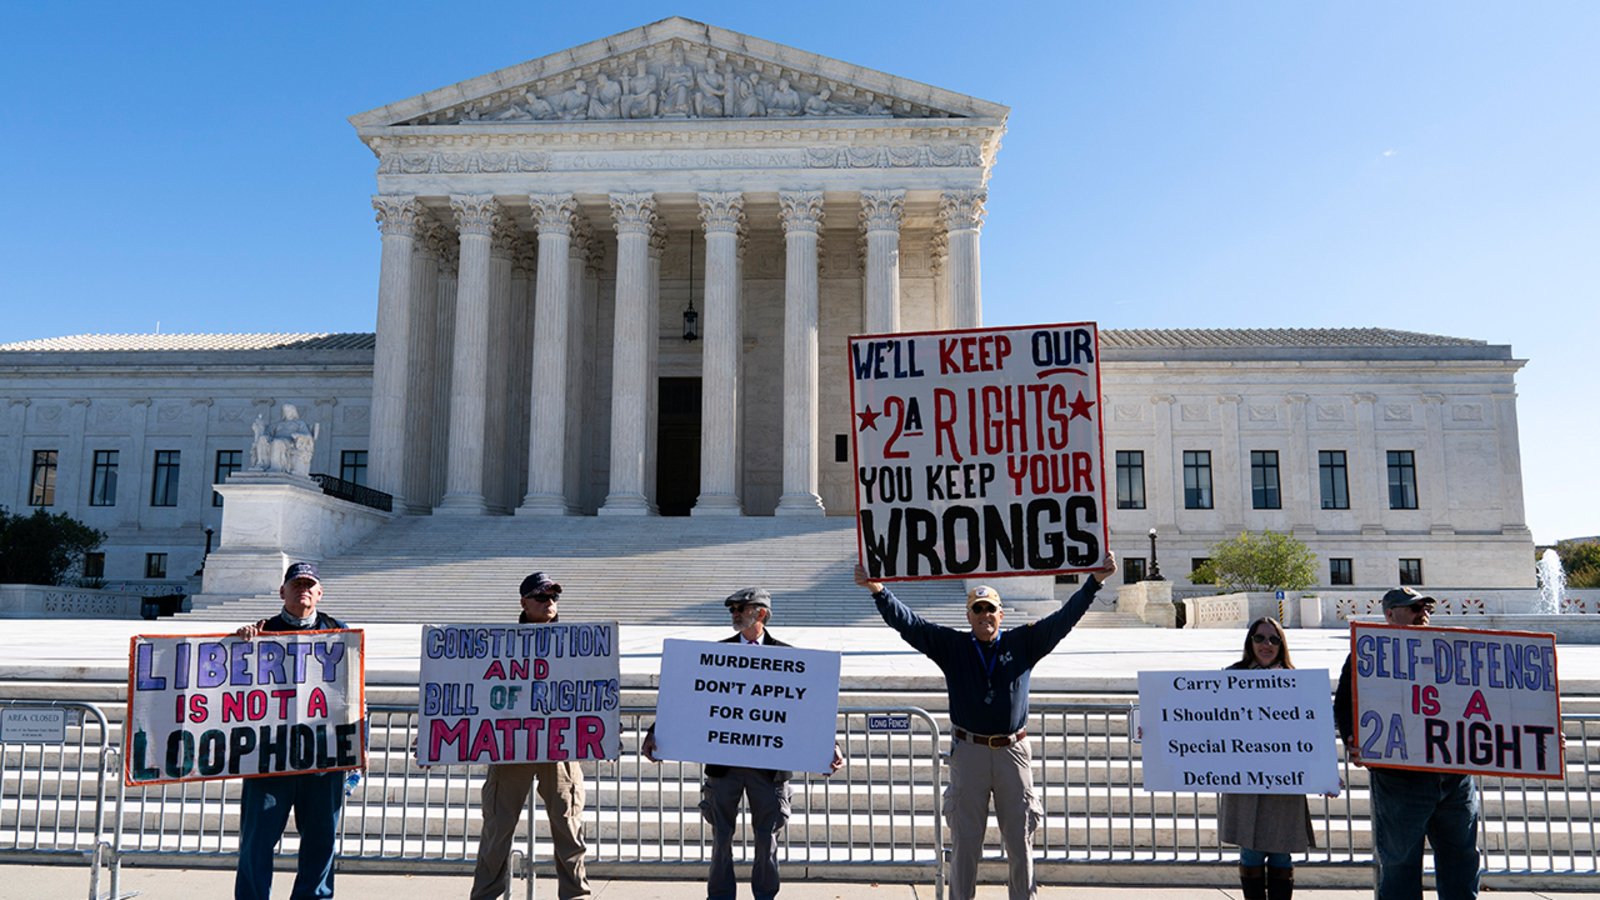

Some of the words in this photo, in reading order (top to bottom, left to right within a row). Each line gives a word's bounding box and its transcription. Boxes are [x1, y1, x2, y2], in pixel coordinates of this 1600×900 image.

[563, 155, 617, 169] EQUAL
[623, 154, 688, 168] JUSTICE
[696, 154, 752, 167] UNDER
[758, 153, 791, 166] LAW
[852, 339, 924, 380] WE'LL
[939, 335, 1012, 375] KEEP
[1031, 328, 1094, 367] OUR
[882, 395, 923, 459] 2A
[933, 383, 1070, 464] RIGHTS
[859, 465, 913, 504] YOU
[926, 462, 995, 501] KEEP
[1007, 451, 1095, 495] YOUR
[860, 495, 1099, 578] WRONGS
[426, 625, 611, 659] CONSTITUTION
[136, 640, 345, 691] LIBERTY
[483, 659, 549, 680] AND
[700, 653, 806, 673] MURDERERS
[1356, 634, 1555, 692] SELF-DEFENSE
[424, 682, 479, 716] BILL
[489, 685, 522, 710] OF
[530, 679, 619, 715] RIGHTS
[694, 679, 746, 695] DON'T
[750, 684, 807, 700] APPLY
[1173, 676, 1222, 694] Carry
[1227, 675, 1296, 690] Permits:
[7, 714, 28, 722] AREA
[30, 714, 59, 722] CLOSED
[176, 694, 209, 723] IS
[222, 689, 296, 723] NOT
[307, 687, 328, 718] A
[709, 705, 744, 721] FOR
[749, 708, 787, 724] GUN
[1161, 708, 1168, 722] I
[1173, 706, 1253, 722] Shouldn't
[1258, 706, 1300, 721] Need
[1305, 709, 1315, 720] a
[1411, 685, 1441, 716] IS
[1463, 689, 1491, 721] A
[133, 723, 357, 781] LOOPHOLE
[428, 715, 605, 762] MATTER
[707, 730, 784, 749] PERMITS
[1168, 739, 1226, 757] Special
[1231, 738, 1292, 753] Reason
[1297, 740, 1314, 753] to
[1360, 710, 1408, 760] 2A
[1425, 718, 1554, 771] RIGHT
[1183, 770, 1241, 786] Defend
[1247, 770, 1305, 789] Myself
